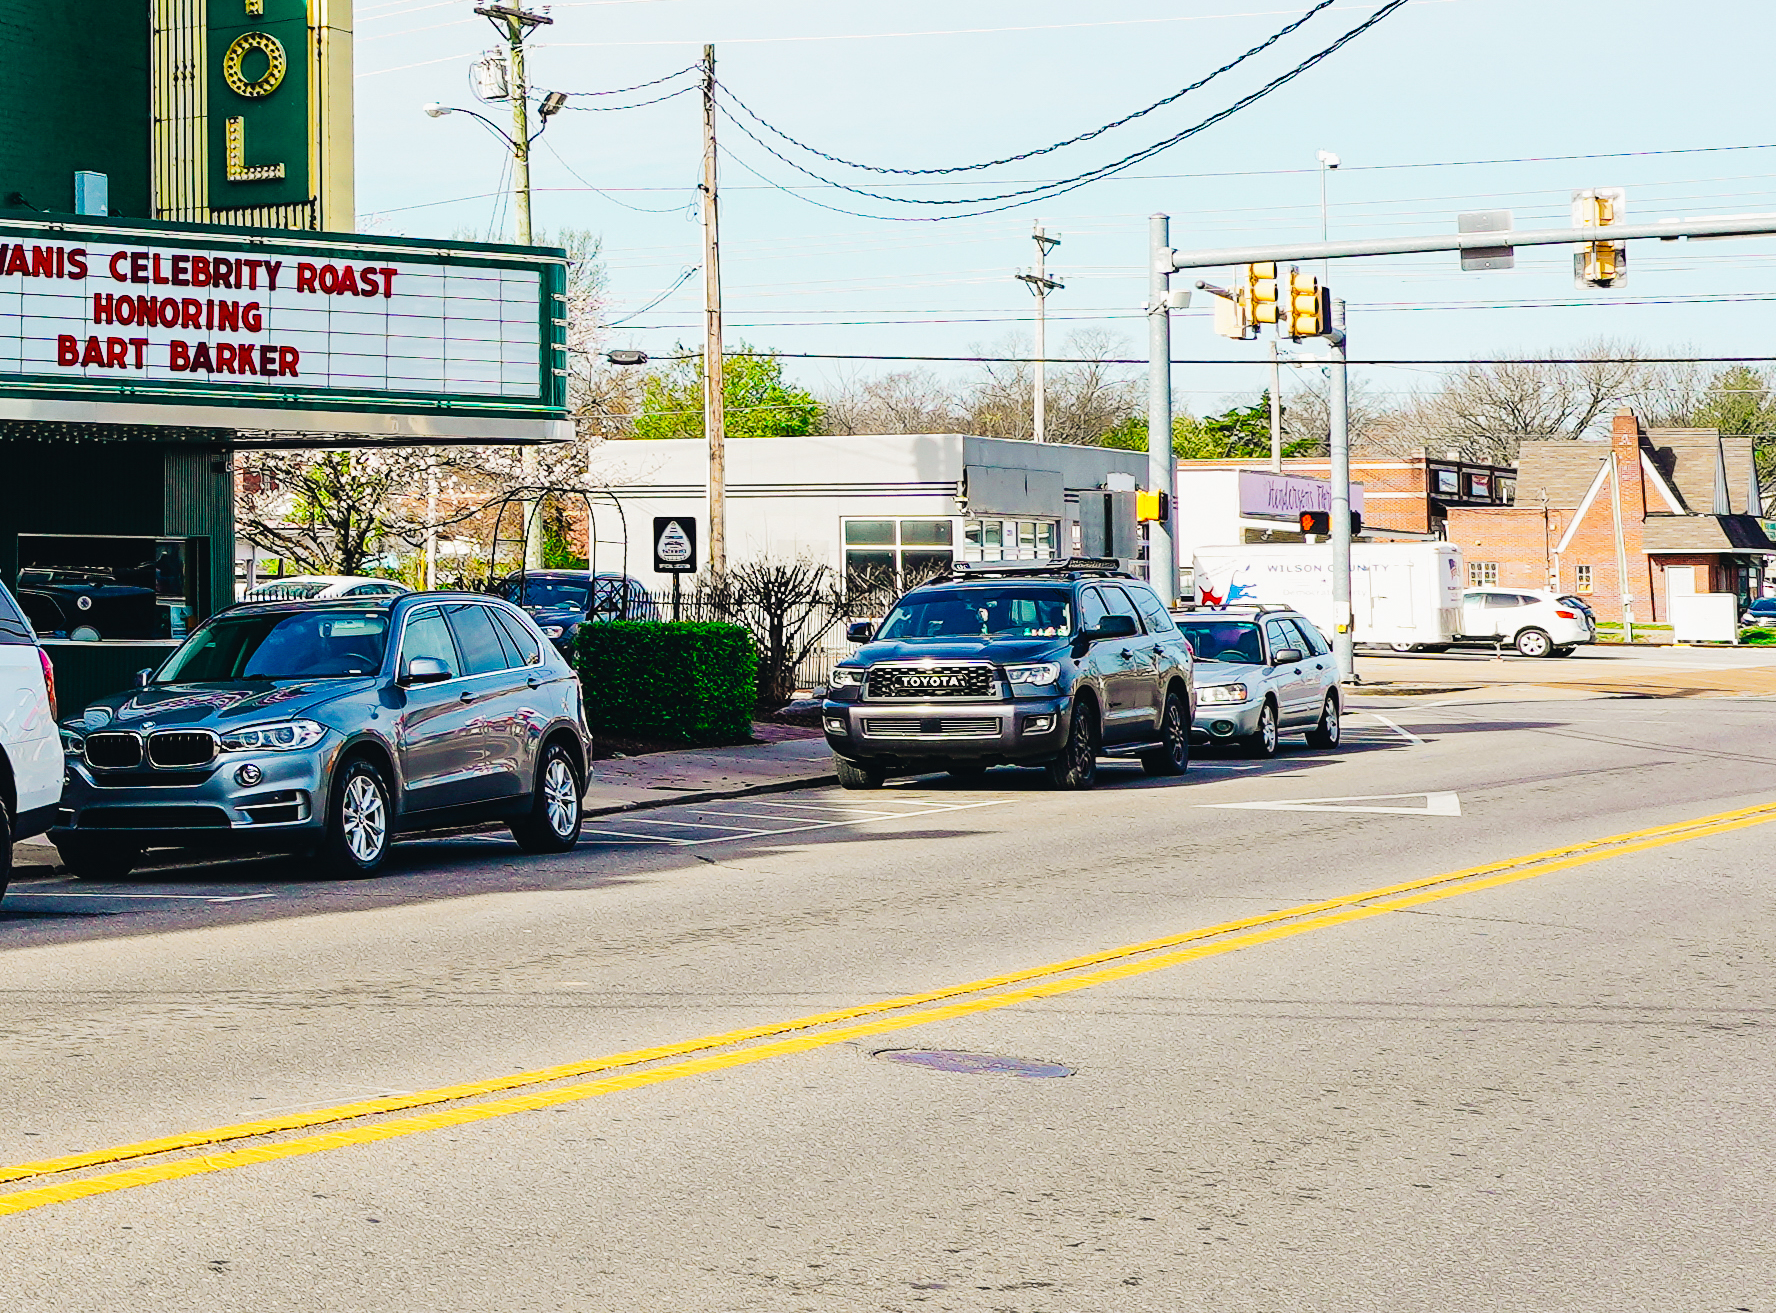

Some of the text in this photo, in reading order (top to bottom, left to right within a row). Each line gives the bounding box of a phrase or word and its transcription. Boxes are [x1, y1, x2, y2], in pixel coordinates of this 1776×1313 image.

[109, 251, 282, 292] CELEBRITY
[296, 262, 398, 299] ROAST
[93, 292, 262, 333] HONORING
[57, 334, 300, 378] BART BARKER
[1267, 564, 1389, 573] WILSON CUNTY
[901, 676, 959, 687] TOYOTA
